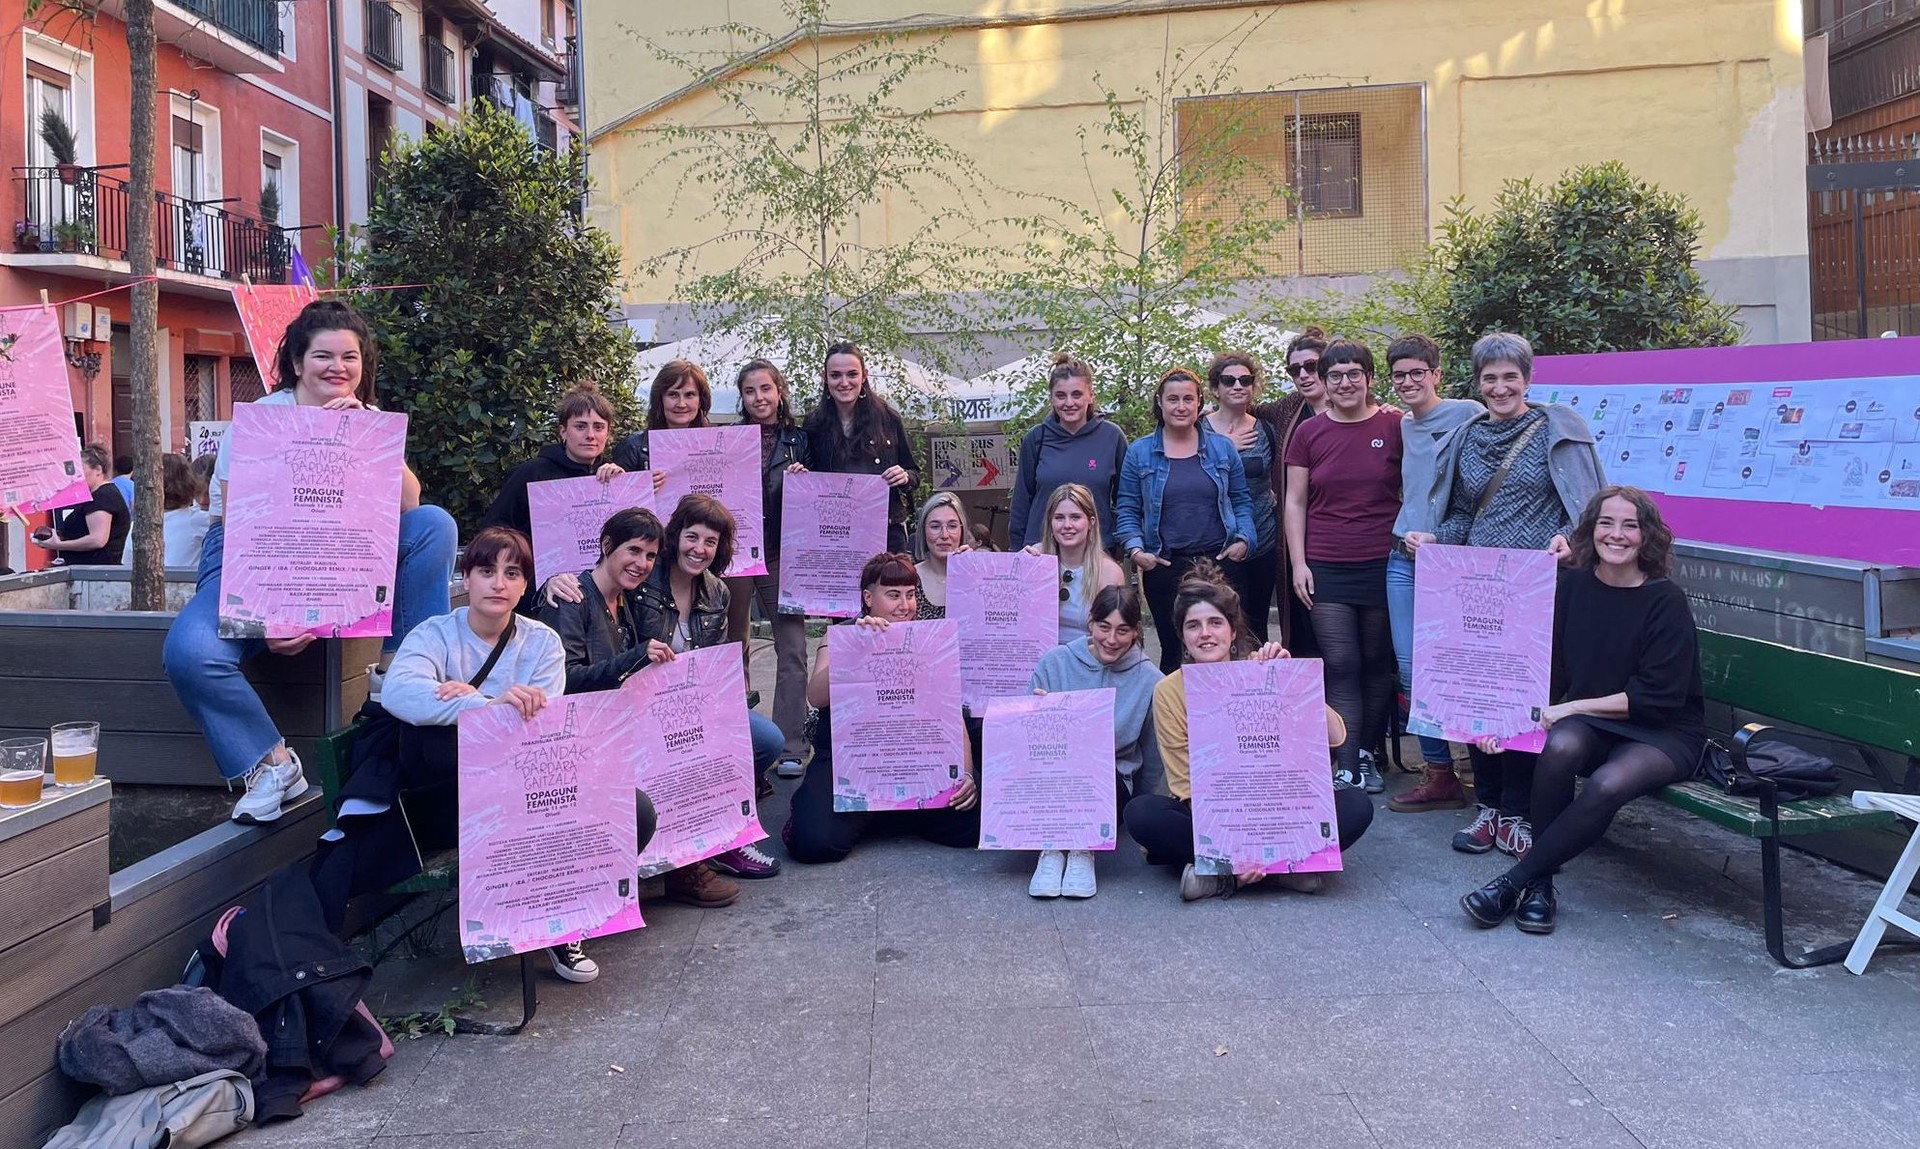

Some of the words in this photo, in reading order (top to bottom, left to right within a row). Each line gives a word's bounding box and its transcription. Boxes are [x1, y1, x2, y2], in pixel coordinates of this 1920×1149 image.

[284, 448, 360, 470] EZTANDAK
[291, 460, 346, 478] DARDARA
[292, 473, 345, 488] GAITZALA
[690, 483, 723, 491] TOPAGUNE
[292, 487, 345, 497] TOPAGUNE
[293, 495, 343, 504] FEMINISTA
[1462, 615, 1504, 625] TOPAGUNE
[1463, 622, 1503, 631] FEMINISTA
[663, 725, 704, 742] TOPAGUNE
[666, 733, 704, 748] FEMINISTA
[1236, 734, 1280, 742] TOPAGUNE
[1028, 743, 1067, 751] TOPAGUNE
[1238, 741, 1280, 749] FEMINISTA
[514, 744, 590, 770] EZTANDAK
[521, 760, 578, 779] DARDARA
[524, 772, 578, 791] GAITZALA
[525, 785, 578, 801] TOPAGUNE
[527, 794, 577, 809] FEMINISTA
[485, 883, 509, 891] GINGER
[531, 871, 565, 882] CHOCOLATE
[566, 868, 584, 876] REMIX
